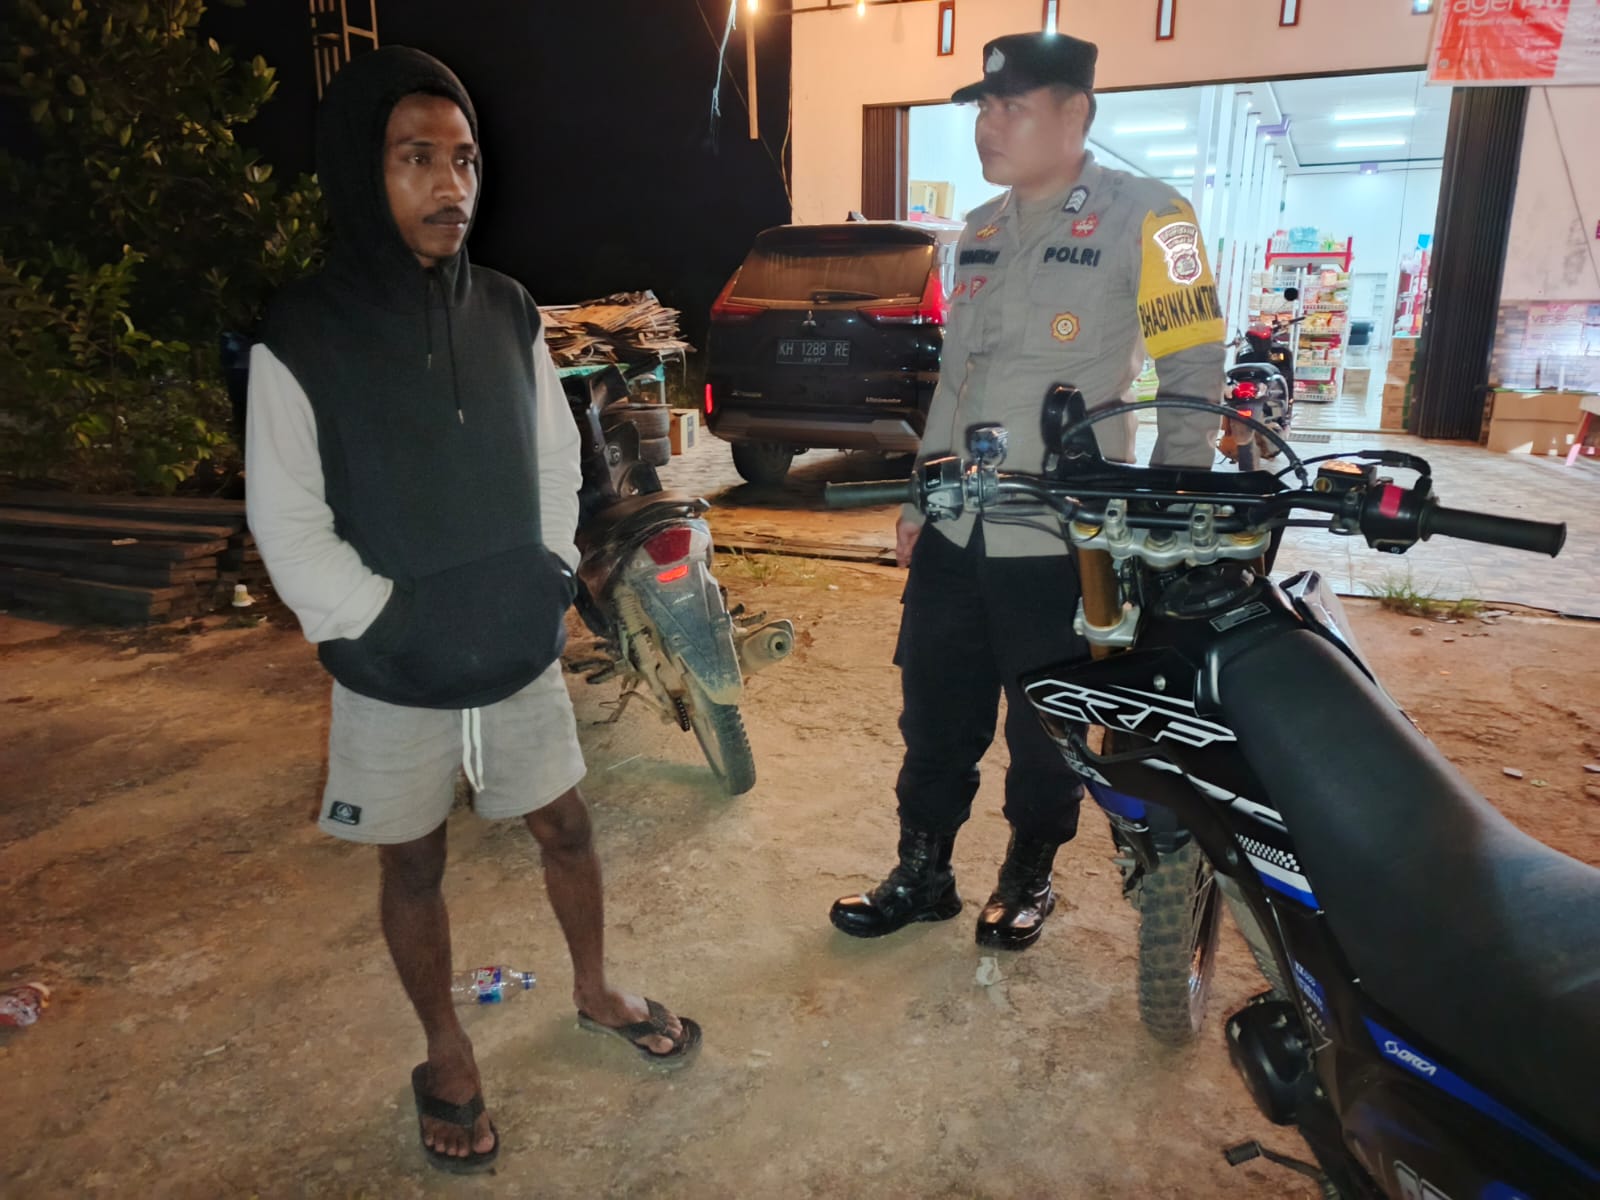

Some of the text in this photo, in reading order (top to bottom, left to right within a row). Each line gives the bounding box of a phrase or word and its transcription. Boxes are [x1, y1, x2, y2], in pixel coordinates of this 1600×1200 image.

[1043, 247, 1101, 267] POLRI
[780, 342, 849, 357] KH 1288 RE
